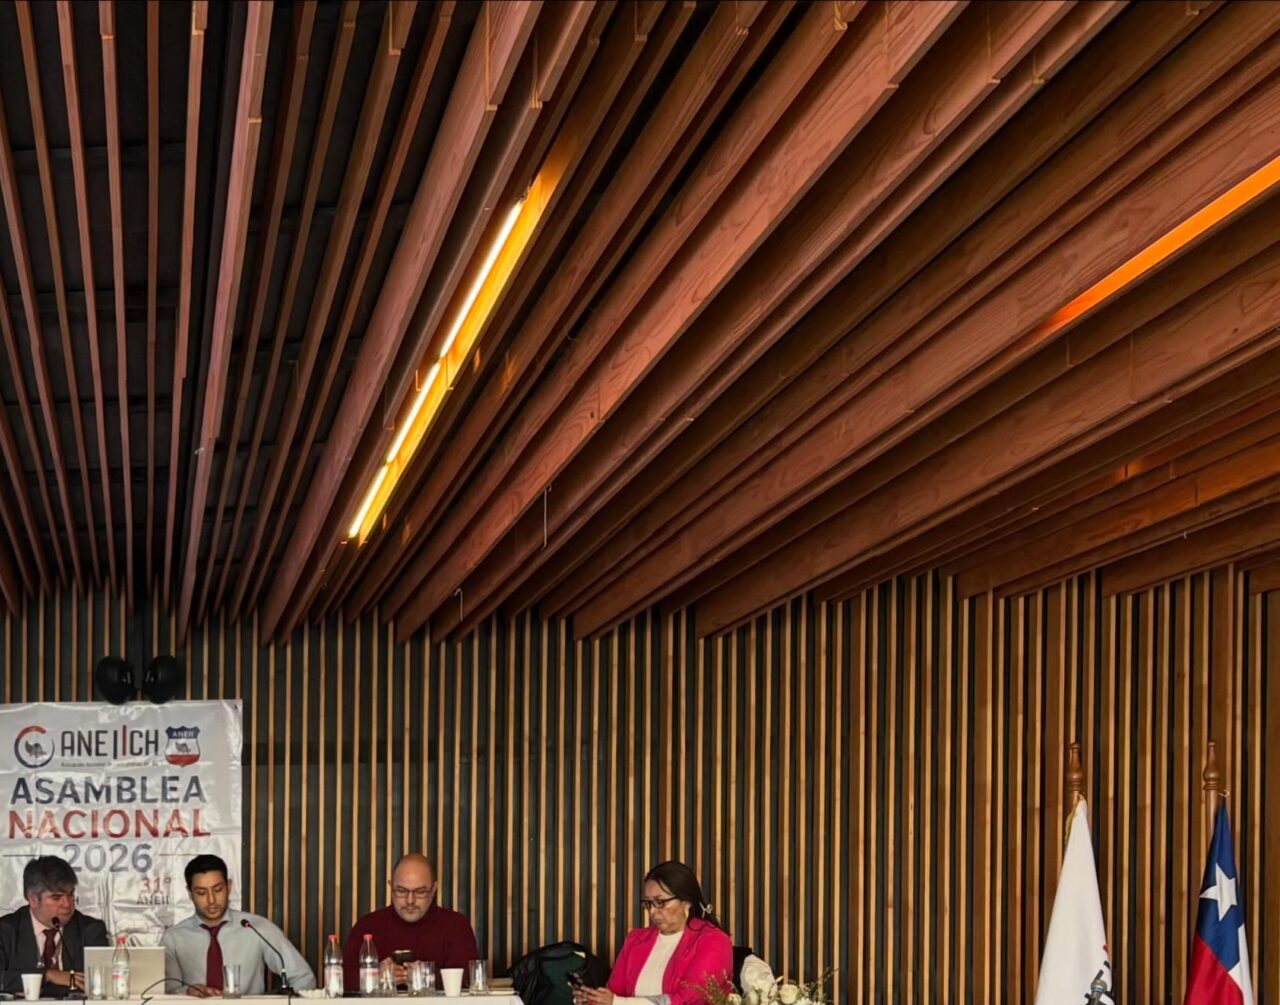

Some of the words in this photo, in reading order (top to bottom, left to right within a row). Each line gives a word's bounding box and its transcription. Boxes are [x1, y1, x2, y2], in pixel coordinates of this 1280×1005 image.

[61, 725, 159, 760] ANEIICH
[10, 776, 208, 804] ASAMBLEA
[8, 808, 211, 839] NACIONAL
[63, 843, 153, 873] 2026
